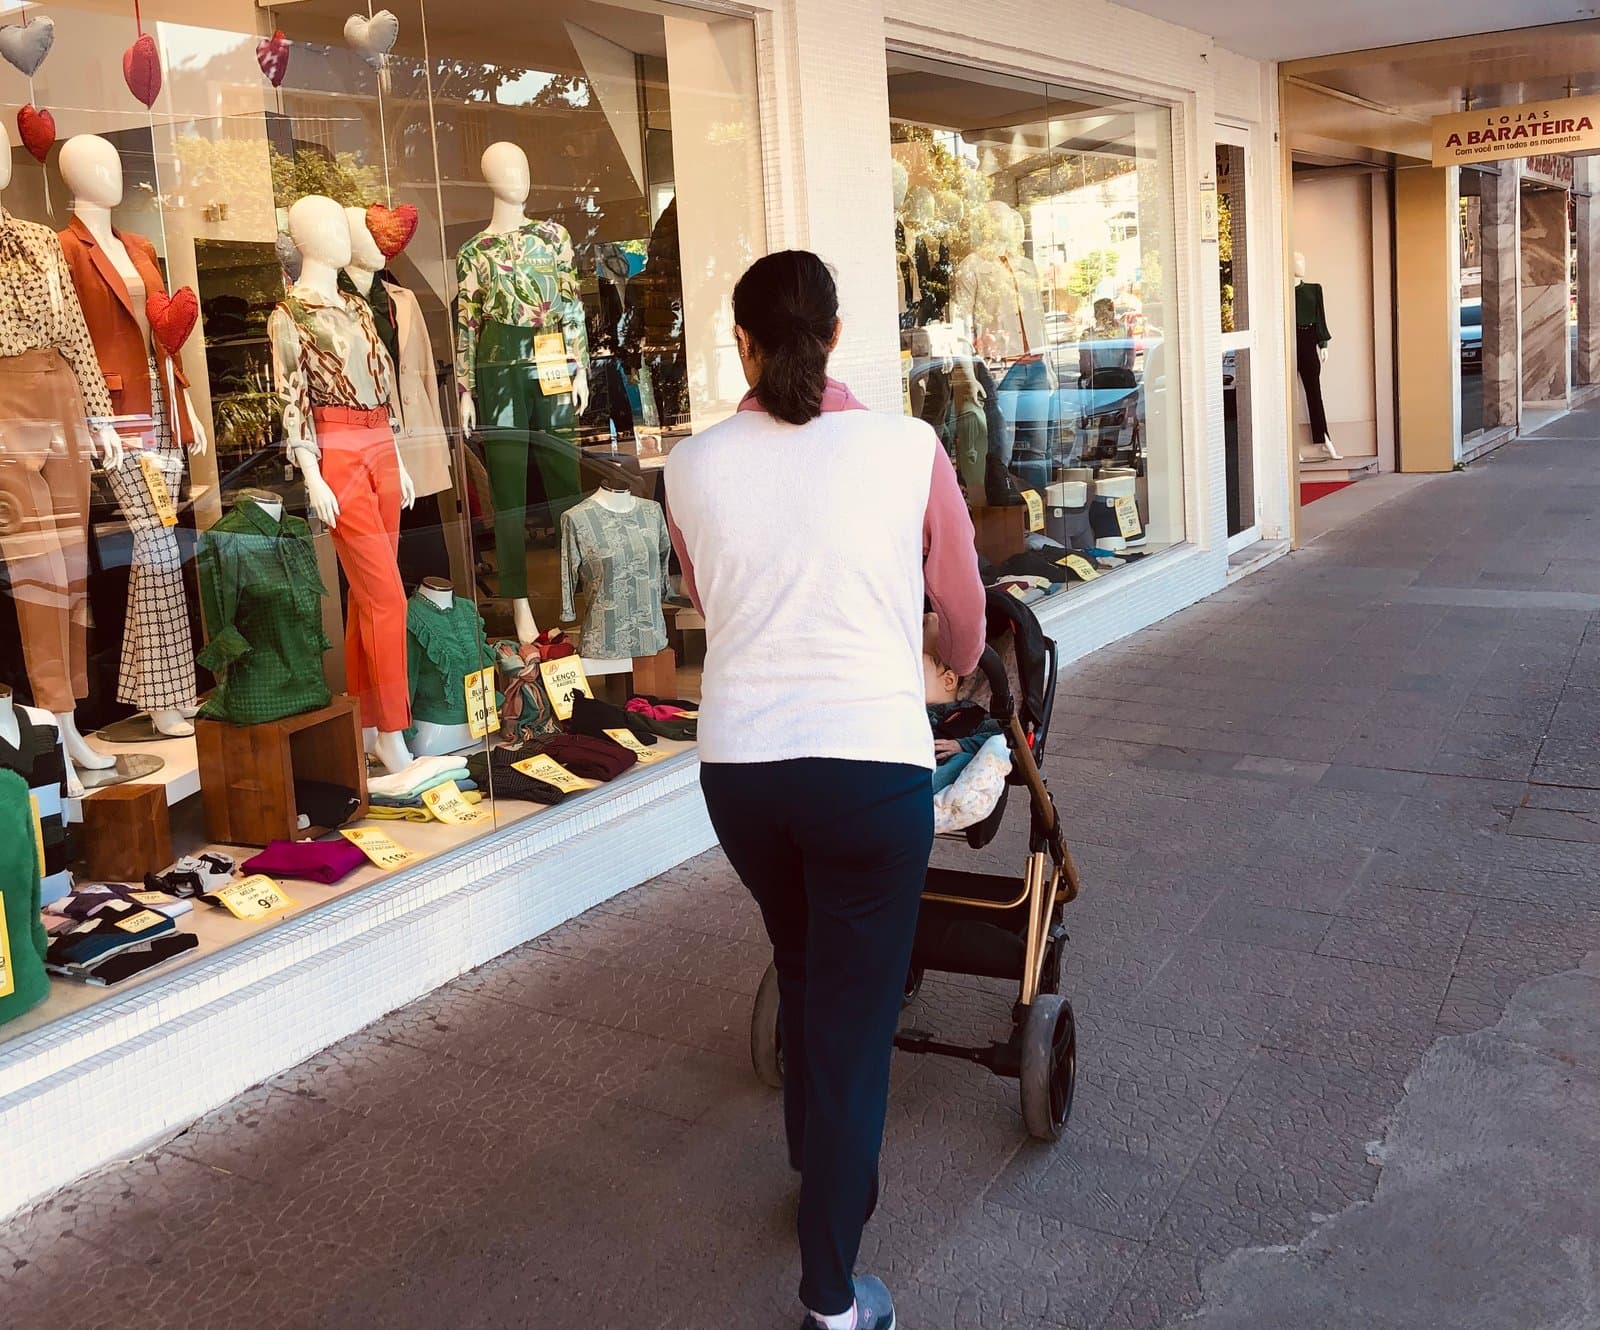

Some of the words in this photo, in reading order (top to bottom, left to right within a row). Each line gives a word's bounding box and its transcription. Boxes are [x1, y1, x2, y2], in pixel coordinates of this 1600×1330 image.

[1488, 110, 1550, 126] LOJAS
[1445, 133, 1462, 148] A
[1467, 117, 1594, 145] BARATEIRA
[1455, 148, 1473, 156] Com
[1474, 144, 1492, 154] você
[1506, 141, 1528, 150] todos
[472, 685, 489, 697] BLUA
